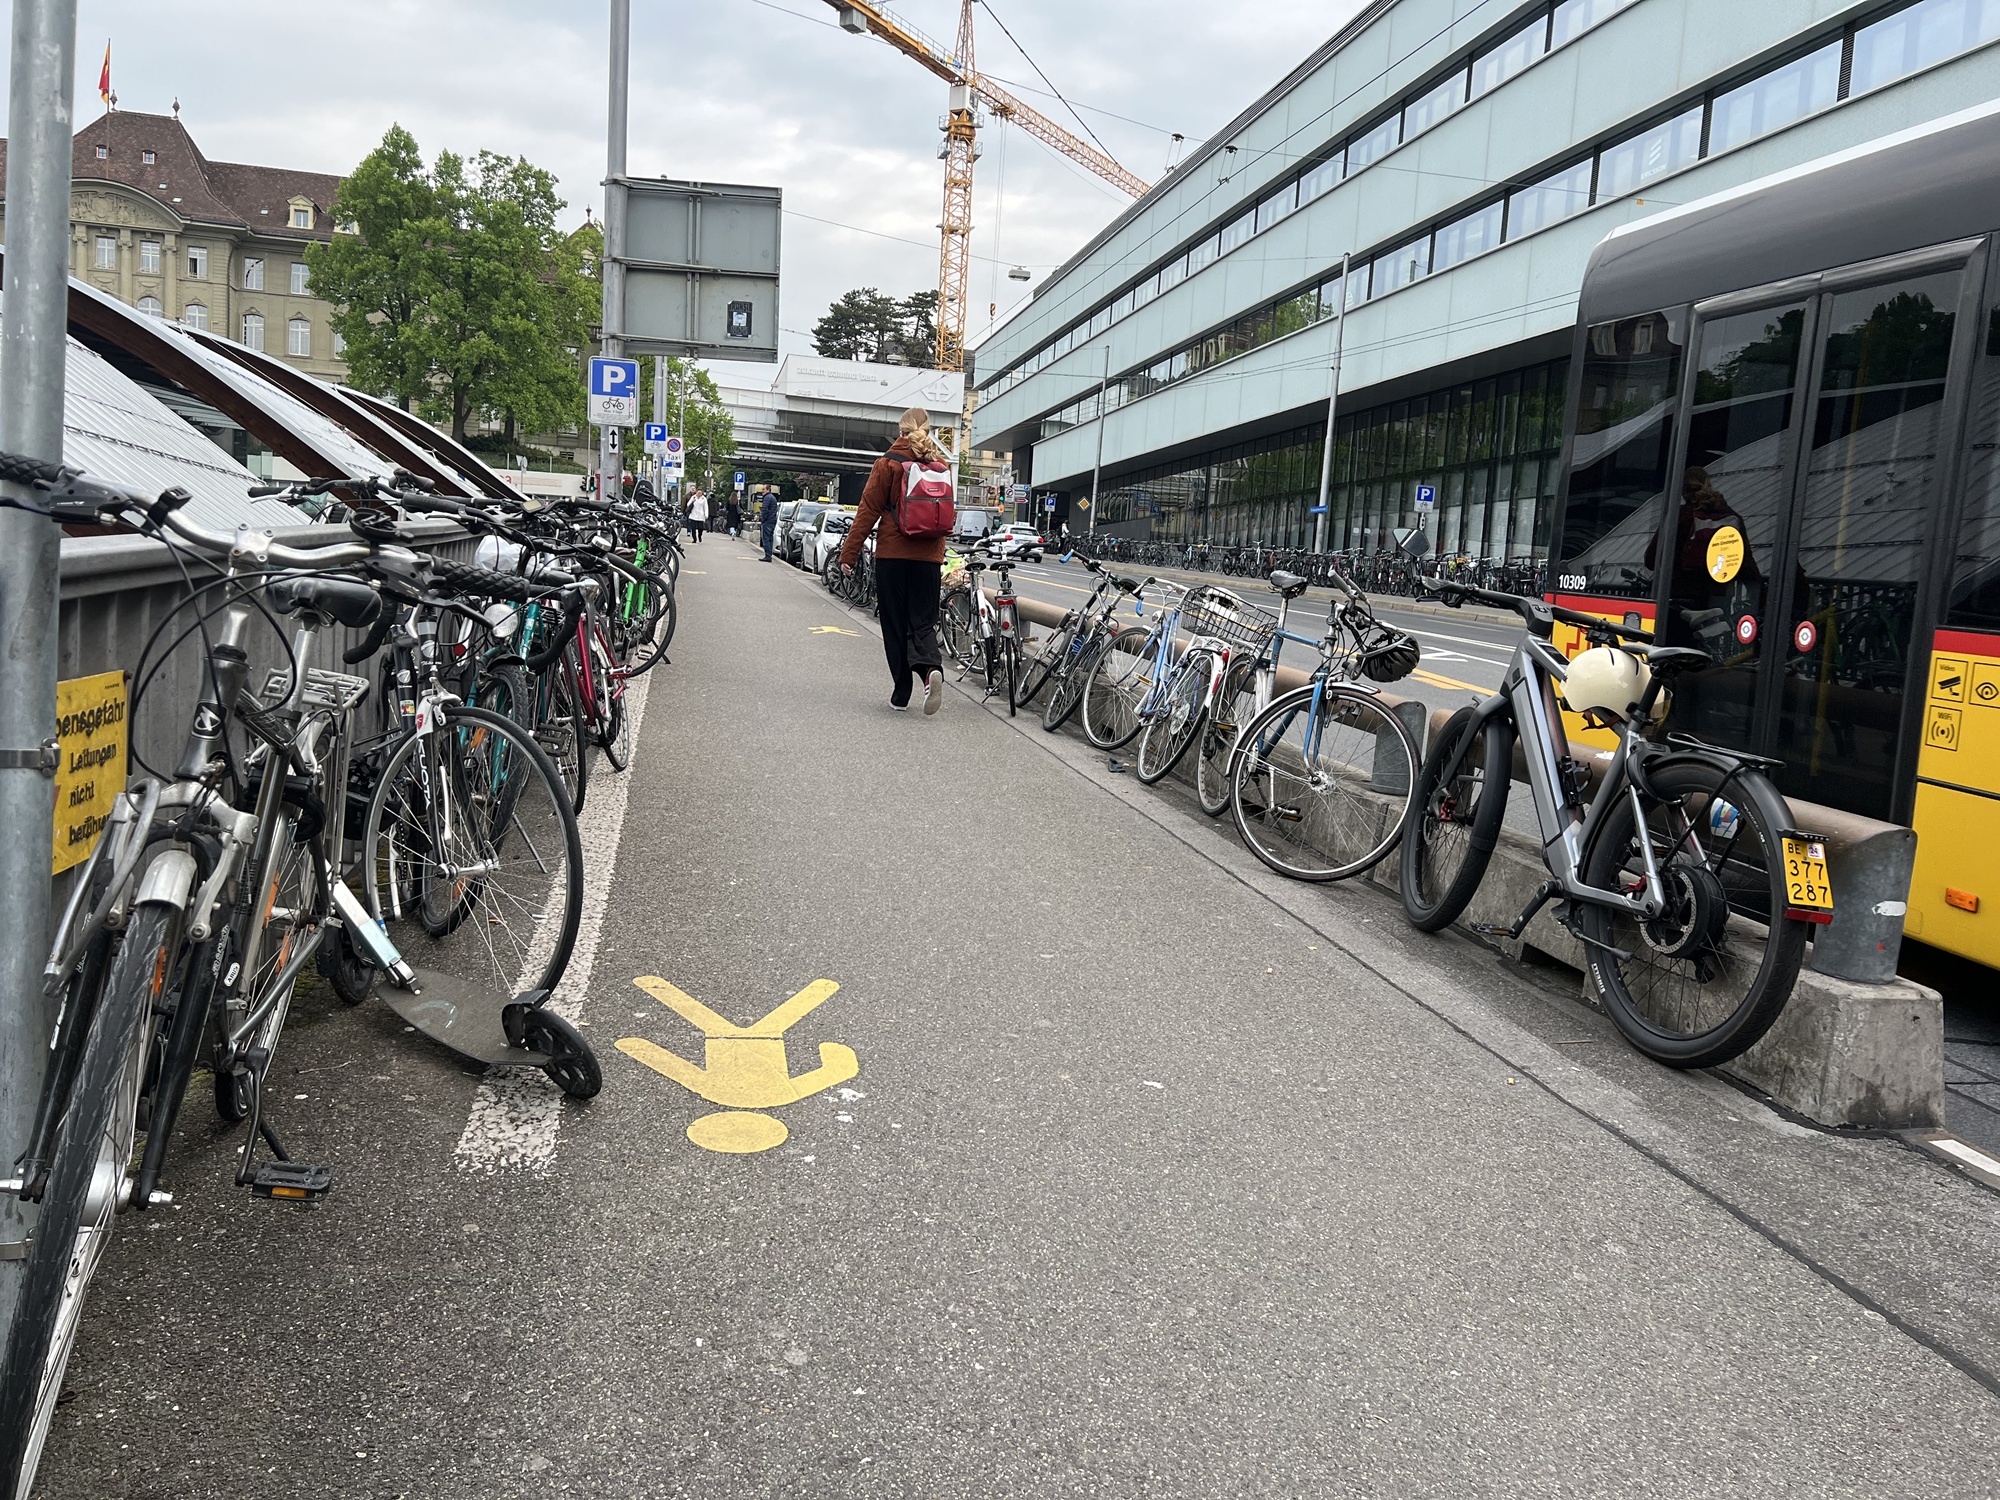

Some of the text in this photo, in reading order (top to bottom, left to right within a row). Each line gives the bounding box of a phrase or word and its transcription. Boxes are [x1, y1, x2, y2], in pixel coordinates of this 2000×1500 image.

[603, 365, 626, 392] P
[651, 426, 662, 439] P
[737, 474, 742, 482] P
[1420, 488, 1431, 500] P
[1559, 574, 1587, 590] 10309
[1938, 712, 1952, 720] WiFi
[69, 743, 116, 774] Leitungen
[417, 738, 431, 810] KUOTA
[69, 780, 95, 808] nicht
[1788, 843, 1801, 854] BE
[1789, 859, 1824, 880] 377
[1791, 883, 1828, 903] 287
[1591, 963, 1606, 994] PIRELLI
